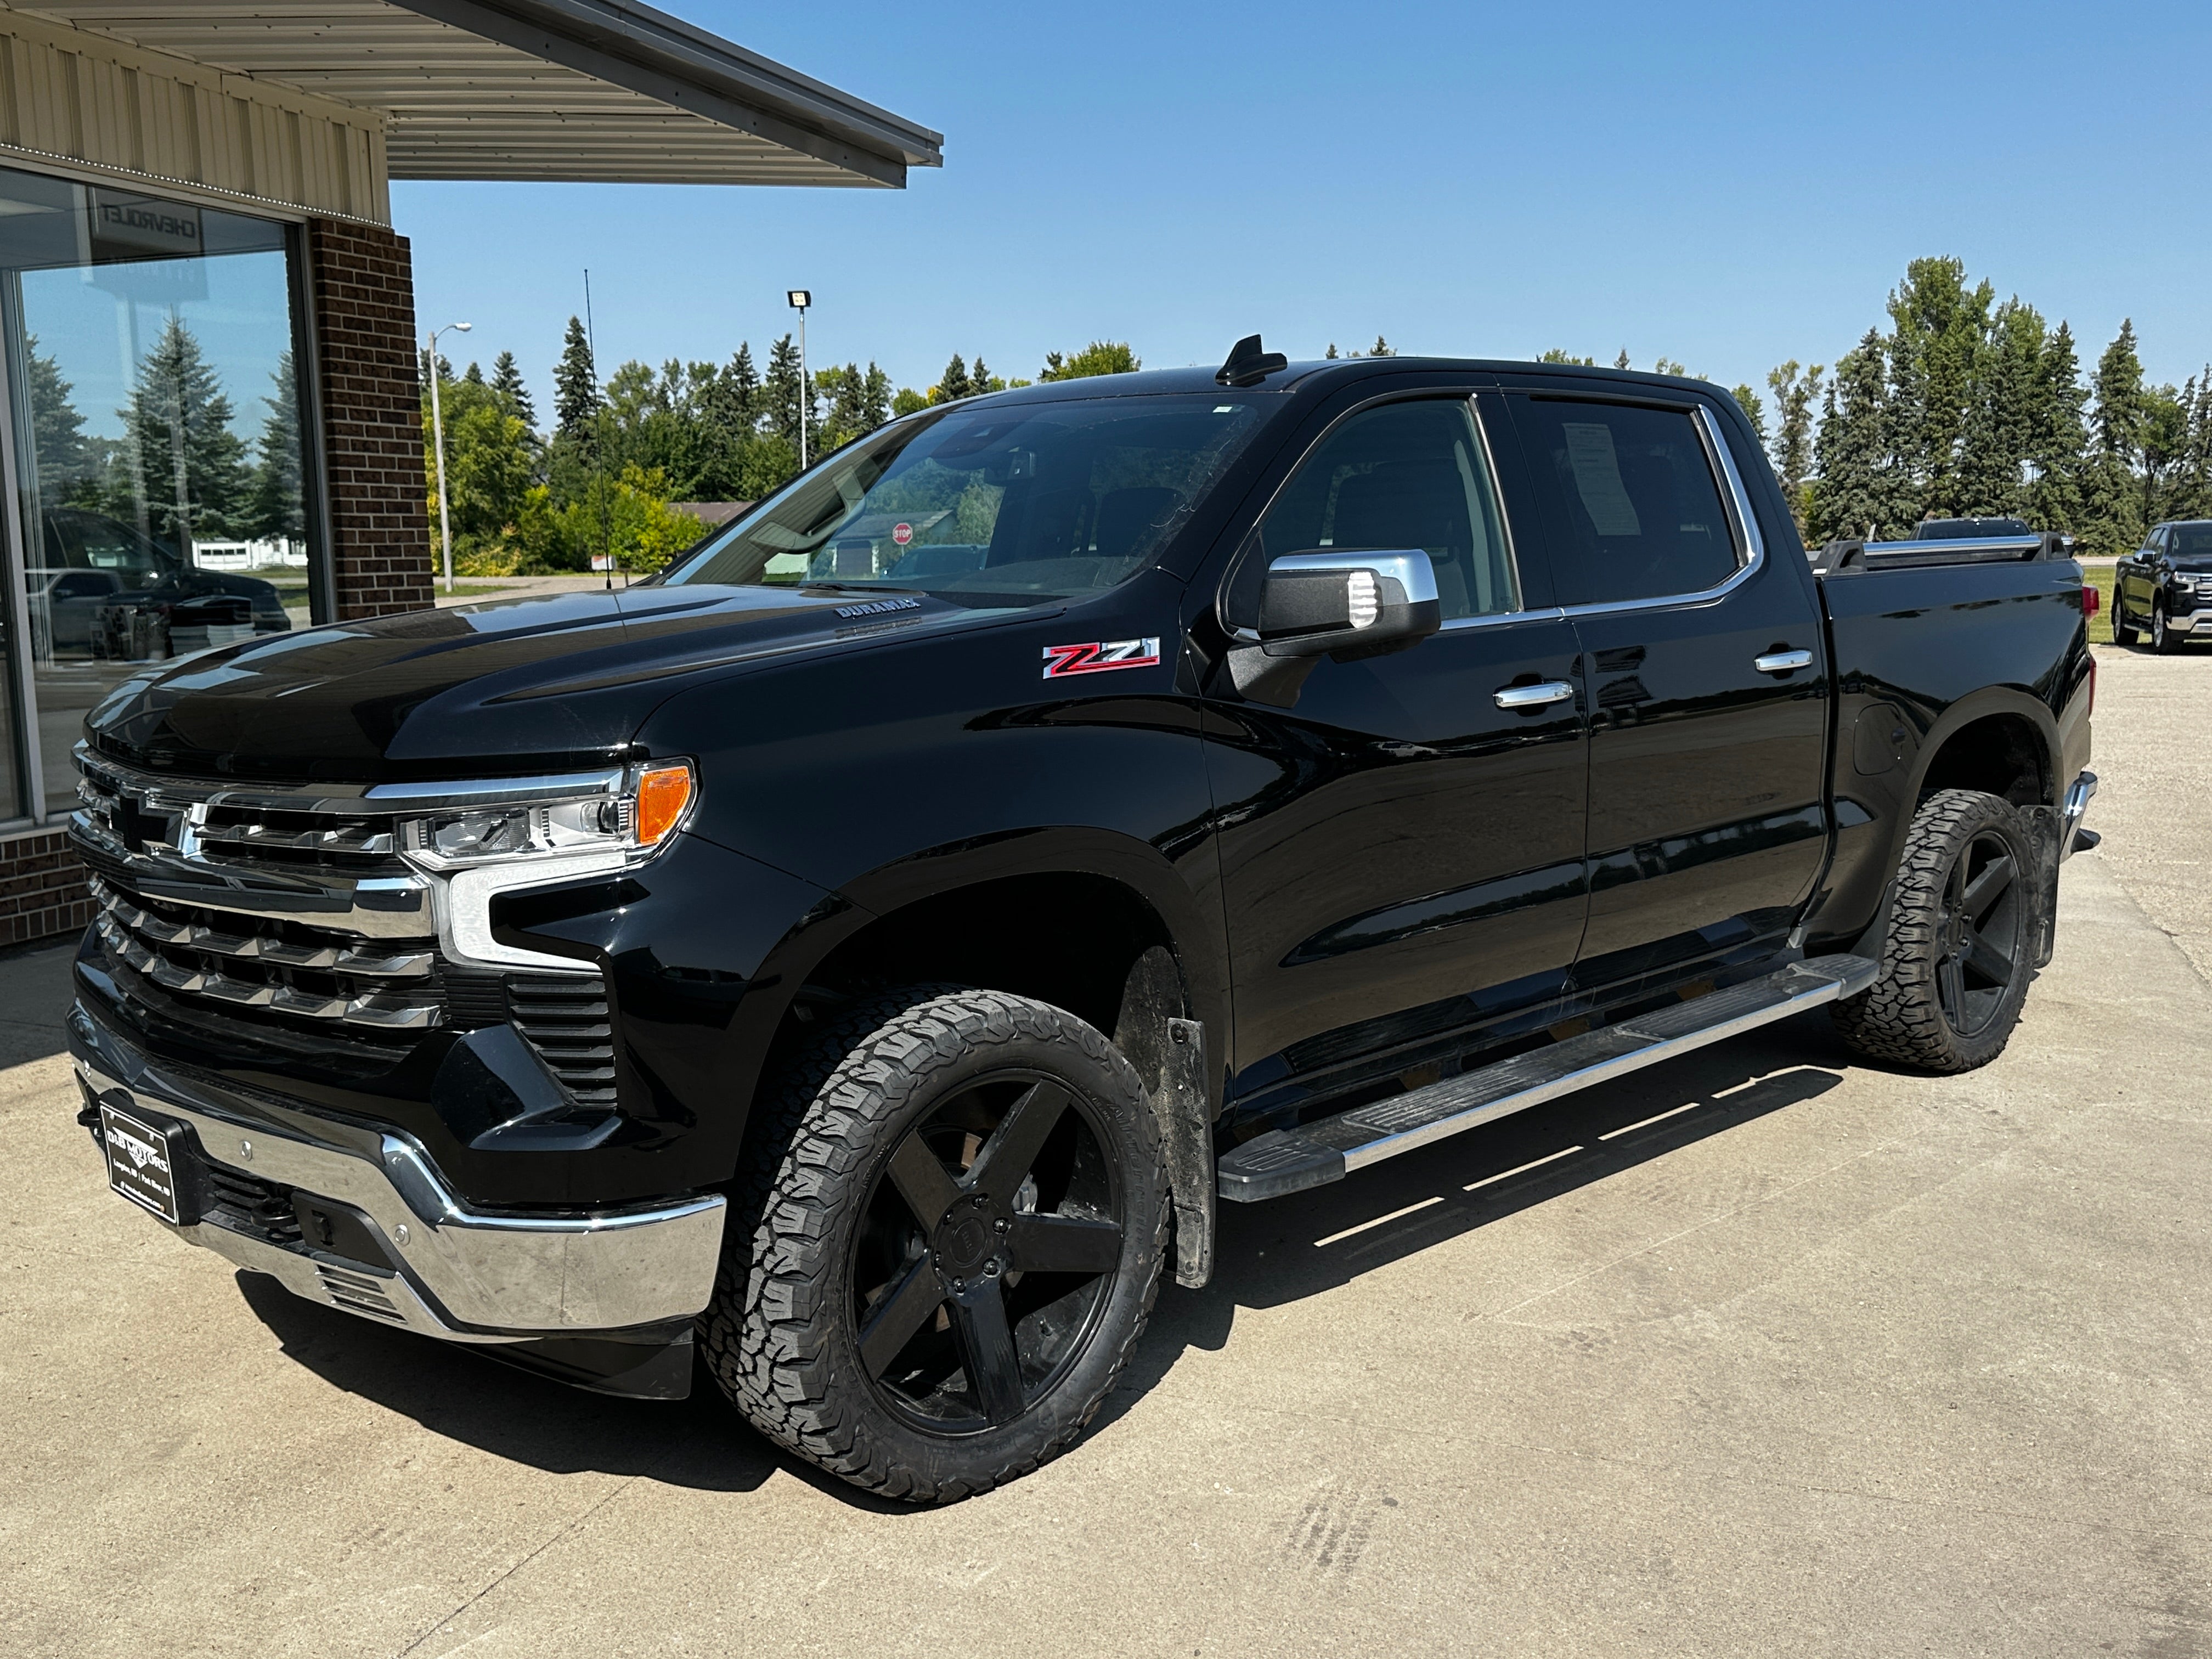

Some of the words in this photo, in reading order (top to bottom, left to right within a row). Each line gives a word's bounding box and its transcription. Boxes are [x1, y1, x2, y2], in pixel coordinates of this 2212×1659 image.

[894, 529, 911, 538] STOP
[833, 598, 921, 618] DURAMAX
[1043, 636, 1160, 680] Z71
[127, 1141, 168, 1173] MOTORS
